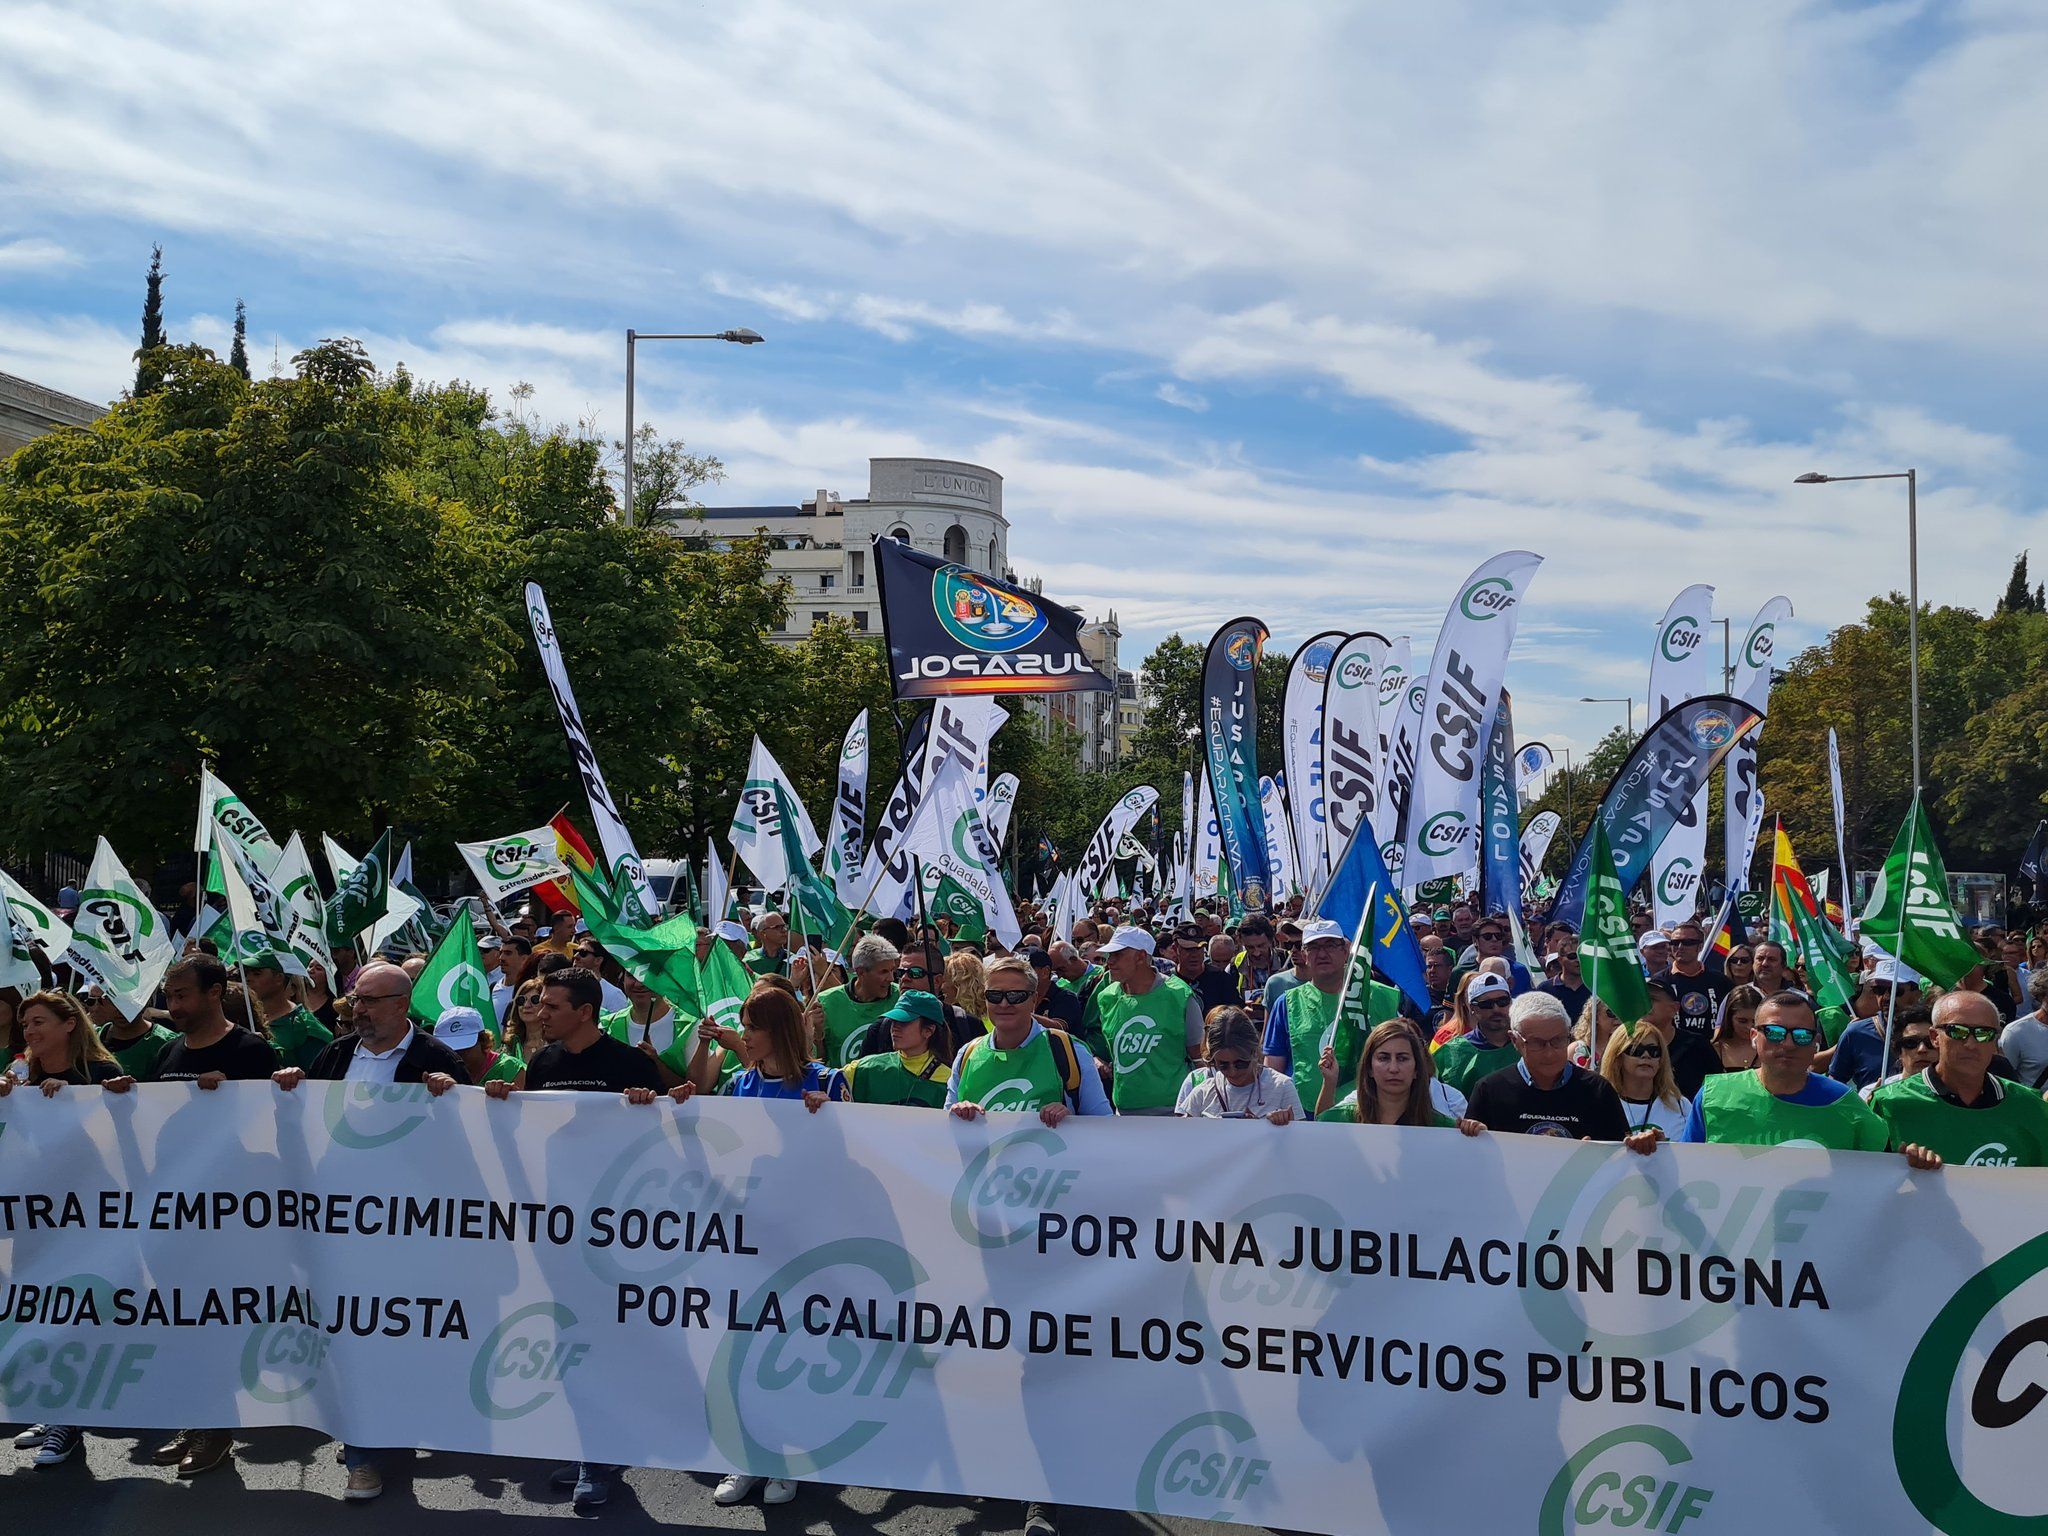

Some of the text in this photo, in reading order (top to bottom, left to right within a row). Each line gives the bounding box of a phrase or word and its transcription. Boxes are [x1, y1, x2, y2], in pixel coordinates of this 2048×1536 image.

[1472, 589, 1516, 611] CSIF
[1669, 629, 1701, 649] CSIF
[1344, 663, 1373, 680] CSIF
[1379, 675, 1408, 694] CSIF
[1430, 649, 1487, 782] CSIF
[1330, 717, 1374, 839] CSIF
[1491, 731, 1511, 861] JUSAPOL
[1079, 815, 1115, 897] CSIF
[1429, 823, 1471, 844] CSIF
[498, 870, 551, 893] Extremadura
[1424, 880, 1449, 890] CSIF
[1667, 872, 1698, 890] CSIF
[951, 896, 978, 916] CSIF
[1587, 894, 1639, 965] CSIF
[1119, 1033, 1163, 1054] CSIF
[1685, 1017, 1705, 1029] YA!!
[979, 1164, 1082, 1209] CSIF
[0, 1189, 759, 1255] TRA EL EMPOBRECIMIENTO SOCIAL
[1579, 1174, 1830, 1275] CSIF
[1038, 1212, 1830, 1310] POR UNA JUBILACIÓN DIGNA
[112, 1285, 320, 1330] SALARIAL
[326, 1294, 469, 1340] JUSTA
[265, 1324, 331, 1367] CSIF
[493, 1336, 591, 1381] CSIF
[617, 1283, 1830, 1424] POR LA CALIDAD DE LOS SERVICIOS PÚBLICOS
[756, 1309, 952, 1399] CSIF
[2, 1341, 157, 1410] CSIF
[1162, 1448, 1272, 1502] CSIF
[1575, 1472, 1714, 1535] CSIF
